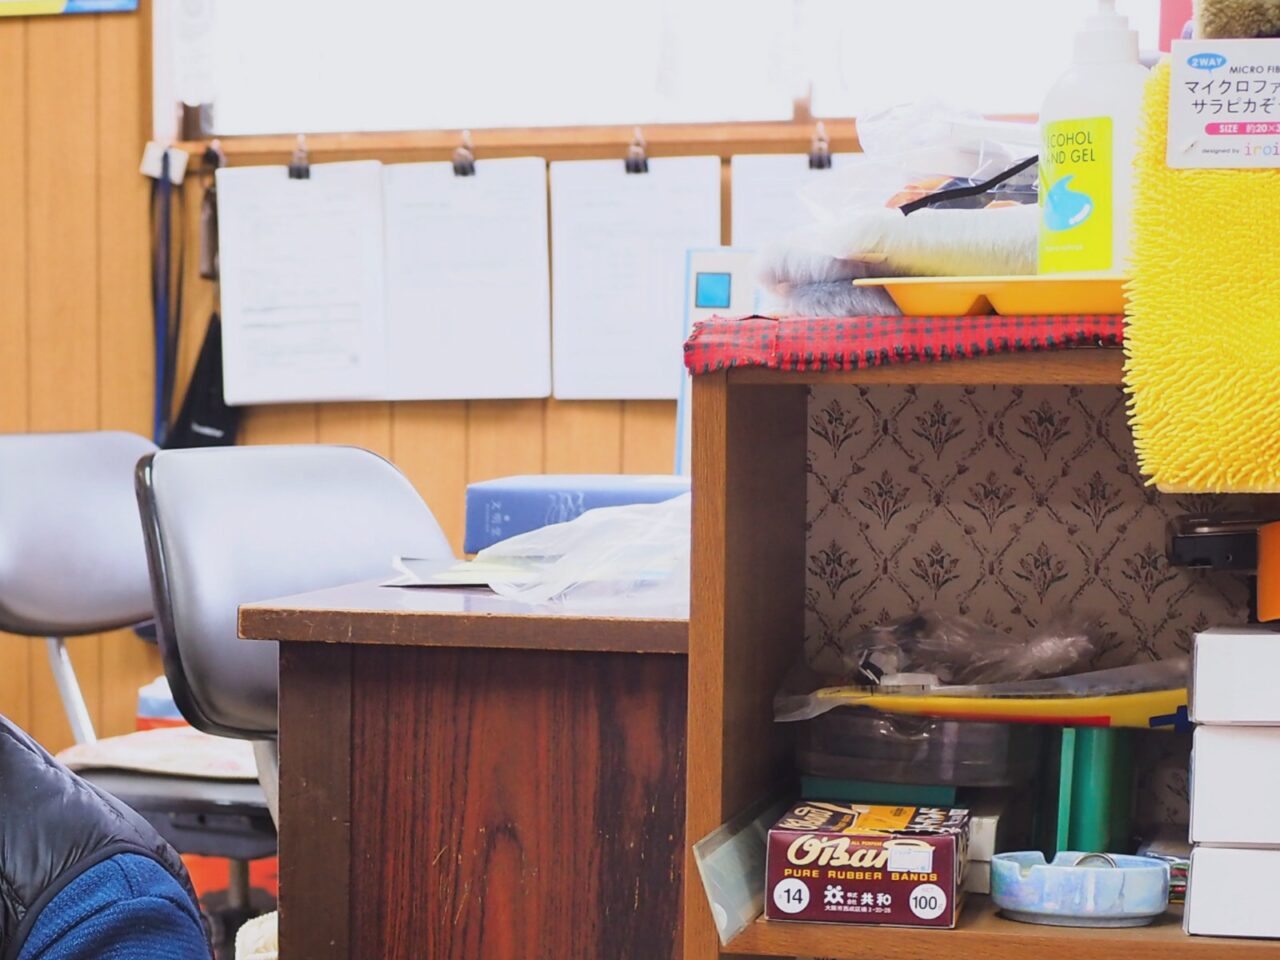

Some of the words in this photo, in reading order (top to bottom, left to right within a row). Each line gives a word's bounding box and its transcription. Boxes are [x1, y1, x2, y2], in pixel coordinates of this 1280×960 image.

[1192, 58, 1223, 67] 2WAY
[1229, 66, 1264, 74] MICRO
[1191, 97, 1280, 115] サラピカぞ
[1219, 124, 1238, 133] SIZE
[1070, 148, 1096, 164] GEL
[1202, 148, 1230, 156] designed
[1232, 148, 1240, 156] by
[784, 868, 820, 878] PURE
[828, 871, 882, 880] RUBBER
[892, 873, 938, 882] BANDS
[784, 888, 803, 905] 14
[912, 895, 938, 910] 100
